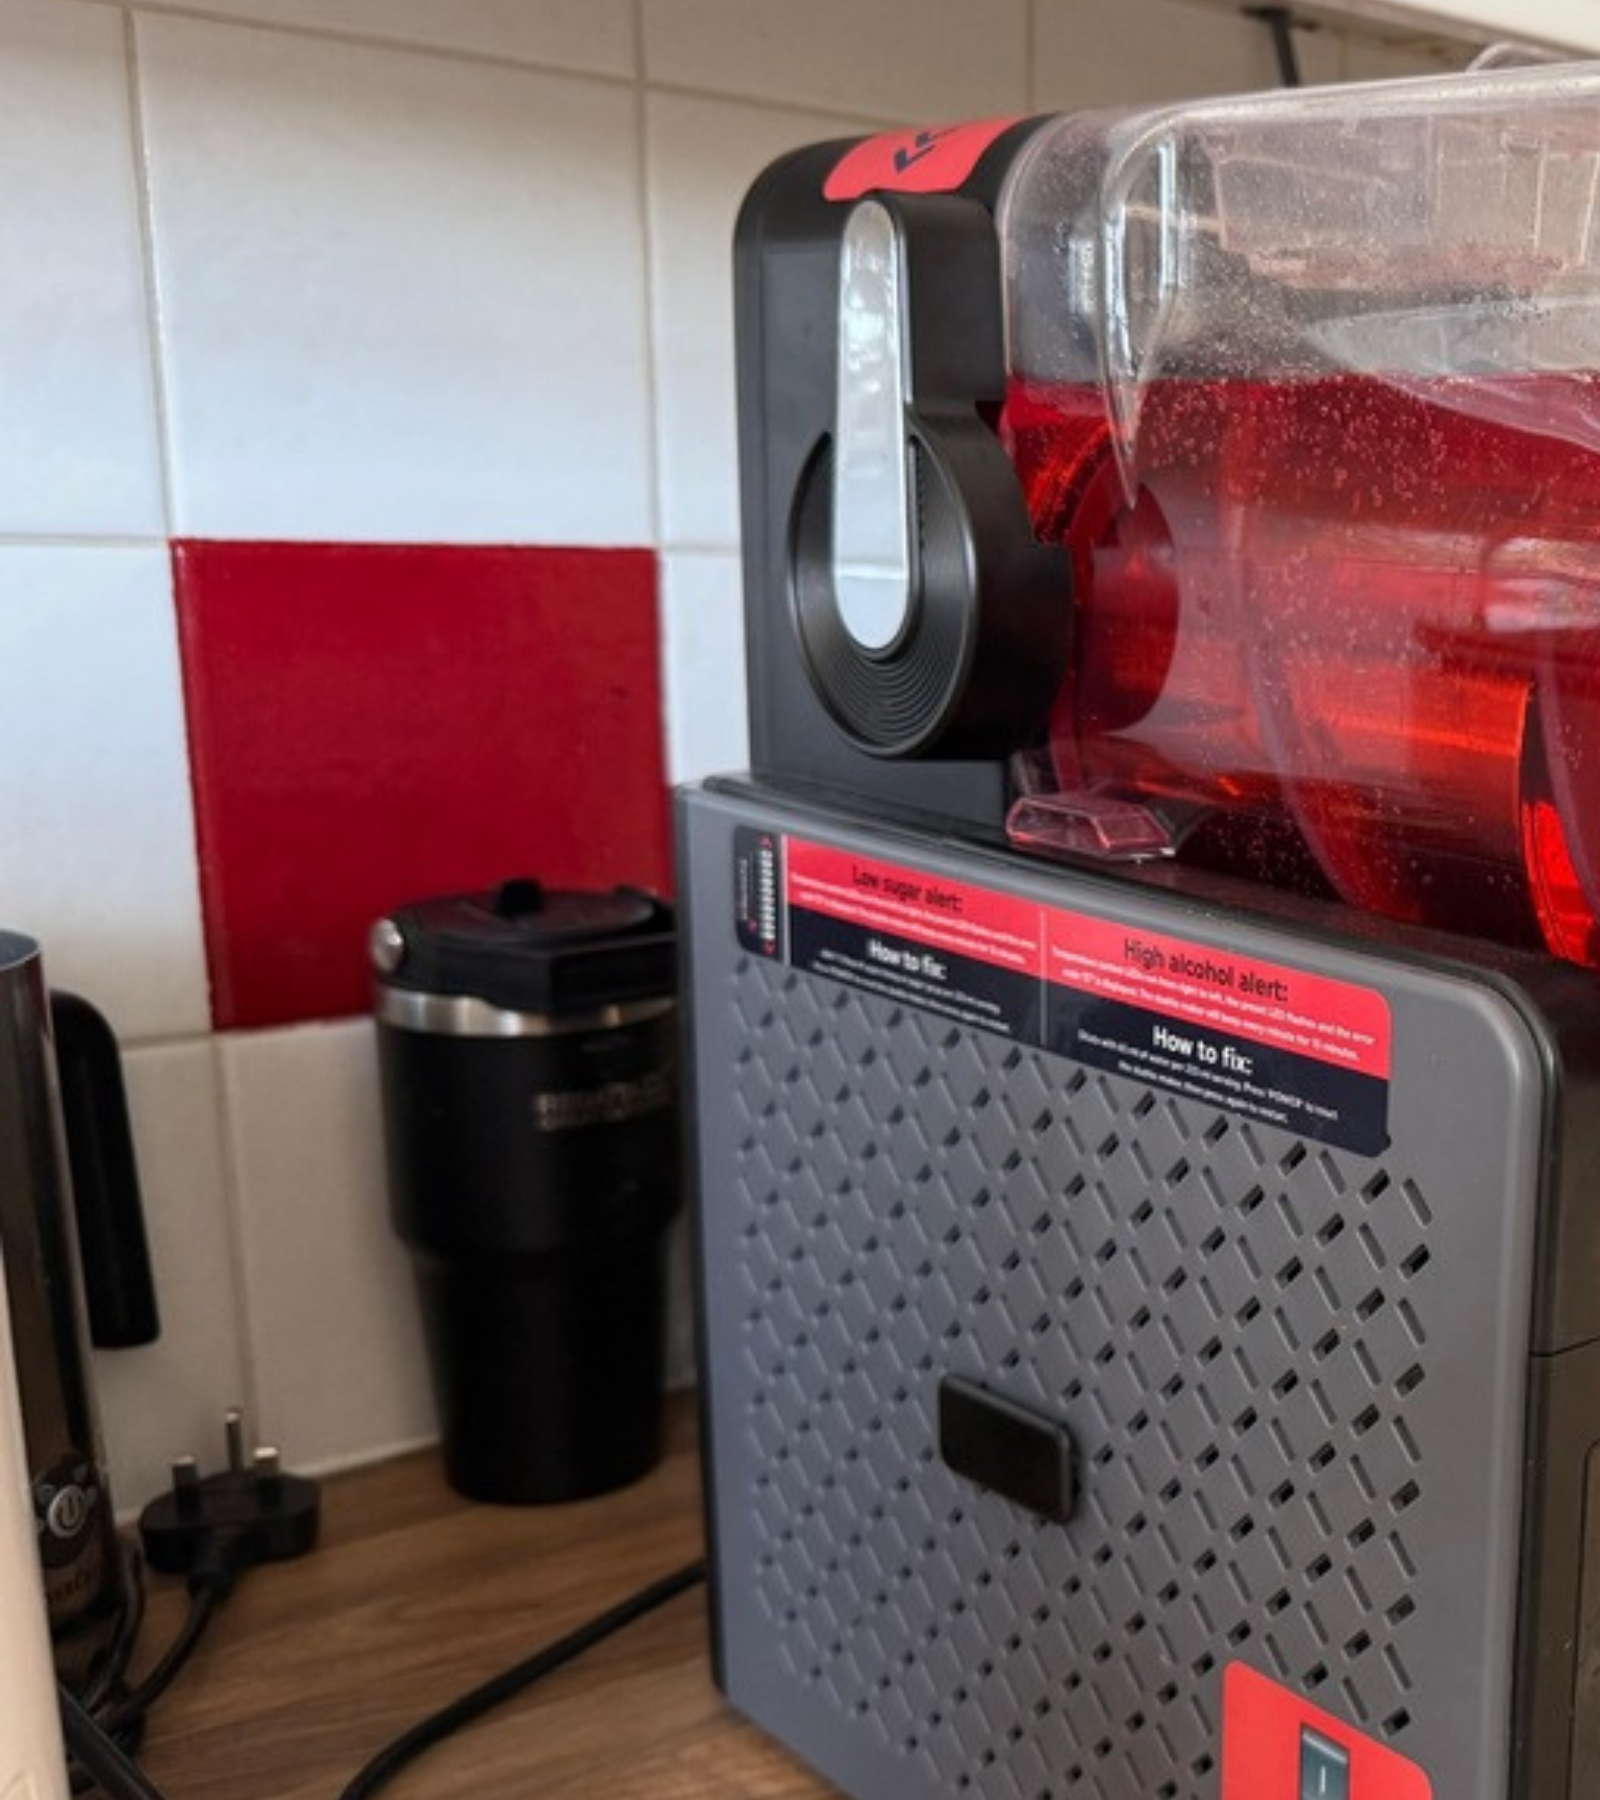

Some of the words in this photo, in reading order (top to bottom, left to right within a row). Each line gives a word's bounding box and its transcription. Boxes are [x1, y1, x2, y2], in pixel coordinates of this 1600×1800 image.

[853, 864, 880, 888] Low
[883, 877, 922, 902] sugar
[924, 886, 963, 912] alert:
[869, 938, 900, 965] How
[901, 950, 919, 971] to
[921, 954, 948, 980] fix:
[1125, 938, 1165, 970] High
[1169, 954, 1235, 987] alcohol
[1239, 971, 1288, 1003] alert:
[1152, 1025, 1194, 1056] How
[1197, 1040, 1217, 1064] to
[1222, 1046, 1252, 1075] fix:
